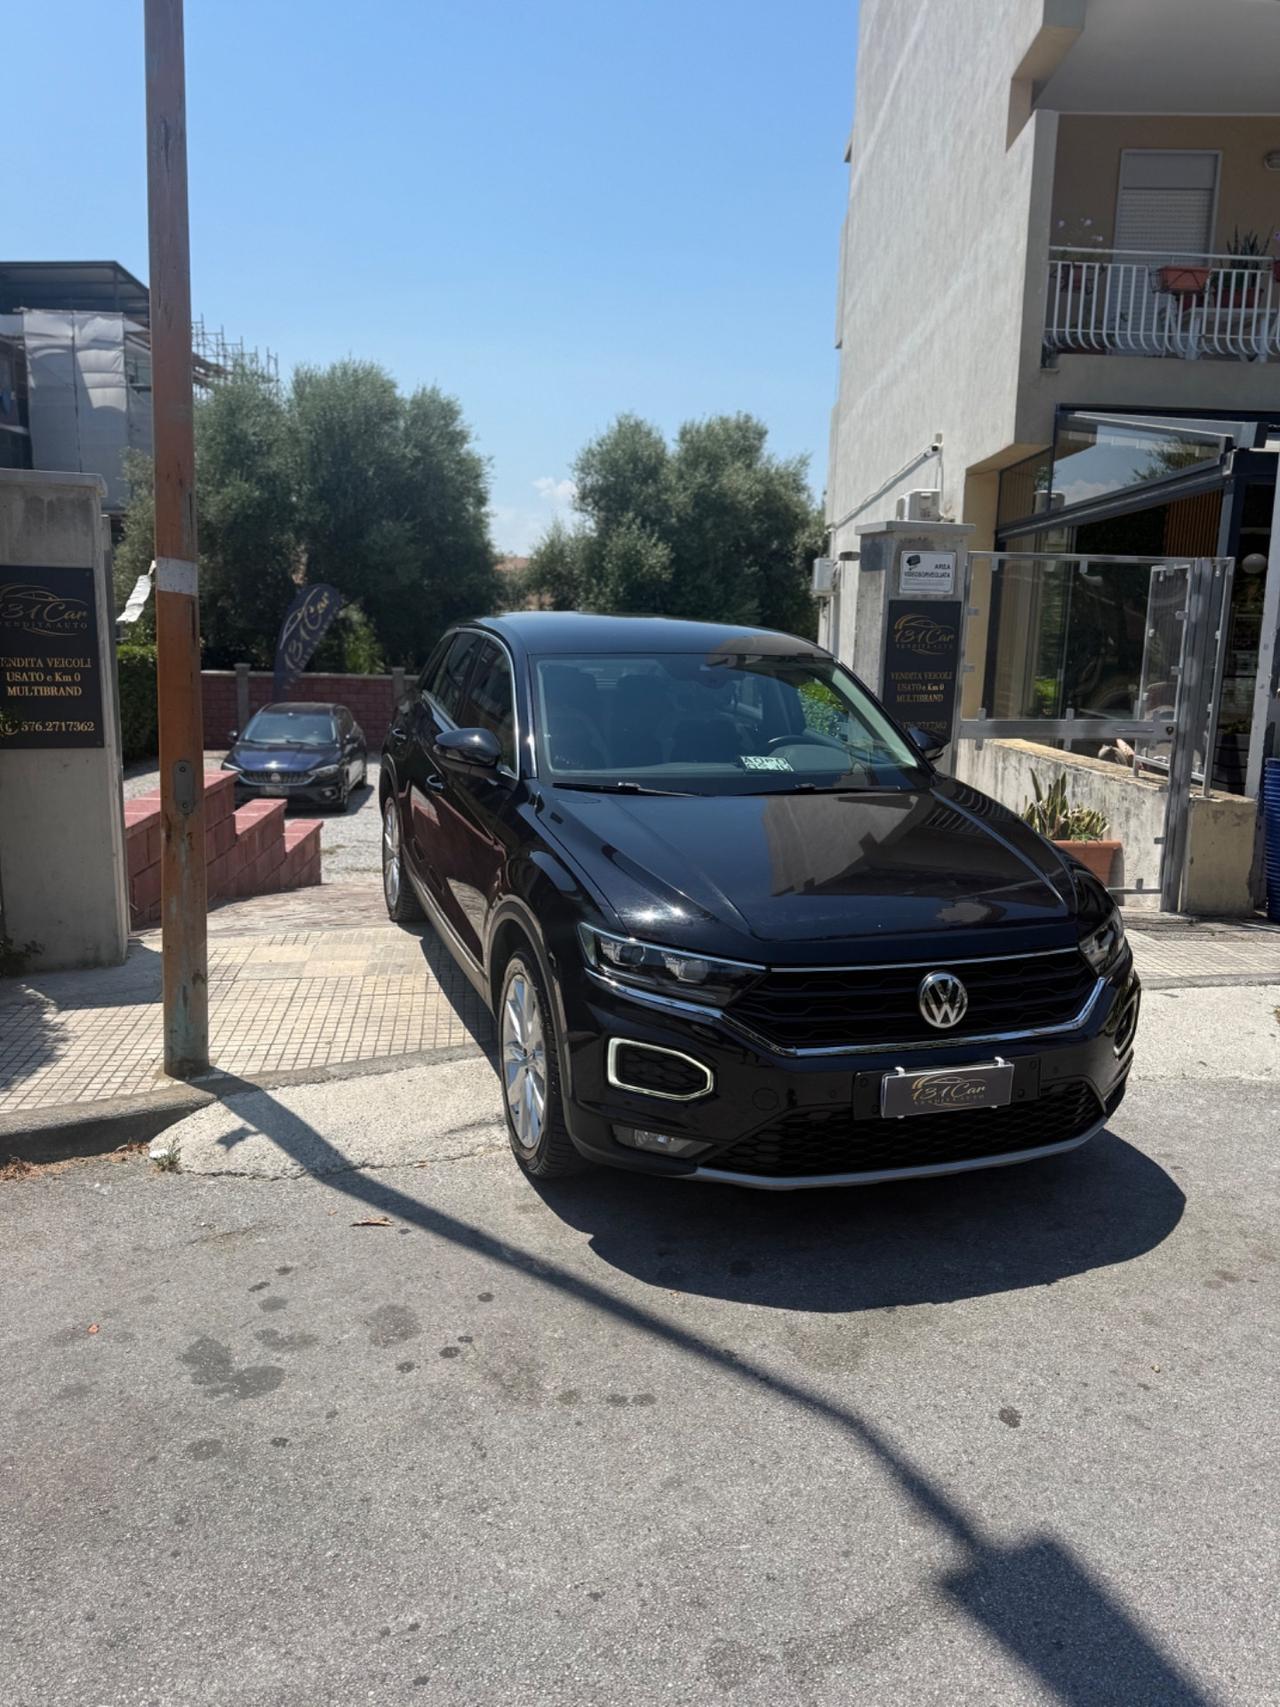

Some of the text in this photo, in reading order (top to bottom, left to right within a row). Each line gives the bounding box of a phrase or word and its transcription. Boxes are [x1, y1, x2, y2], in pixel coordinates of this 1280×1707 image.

[0, 657, 91, 668] ENDITA VEICOLI
[6, 671, 44, 682] USATO
[54, 671, 72, 682] Km
[73, 671, 81, 682] 0
[890, 671, 922, 680] VENDITA
[7, 686, 82, 697] MULTIBRAND
[896, 694, 944, 703] MULTIBRAND
